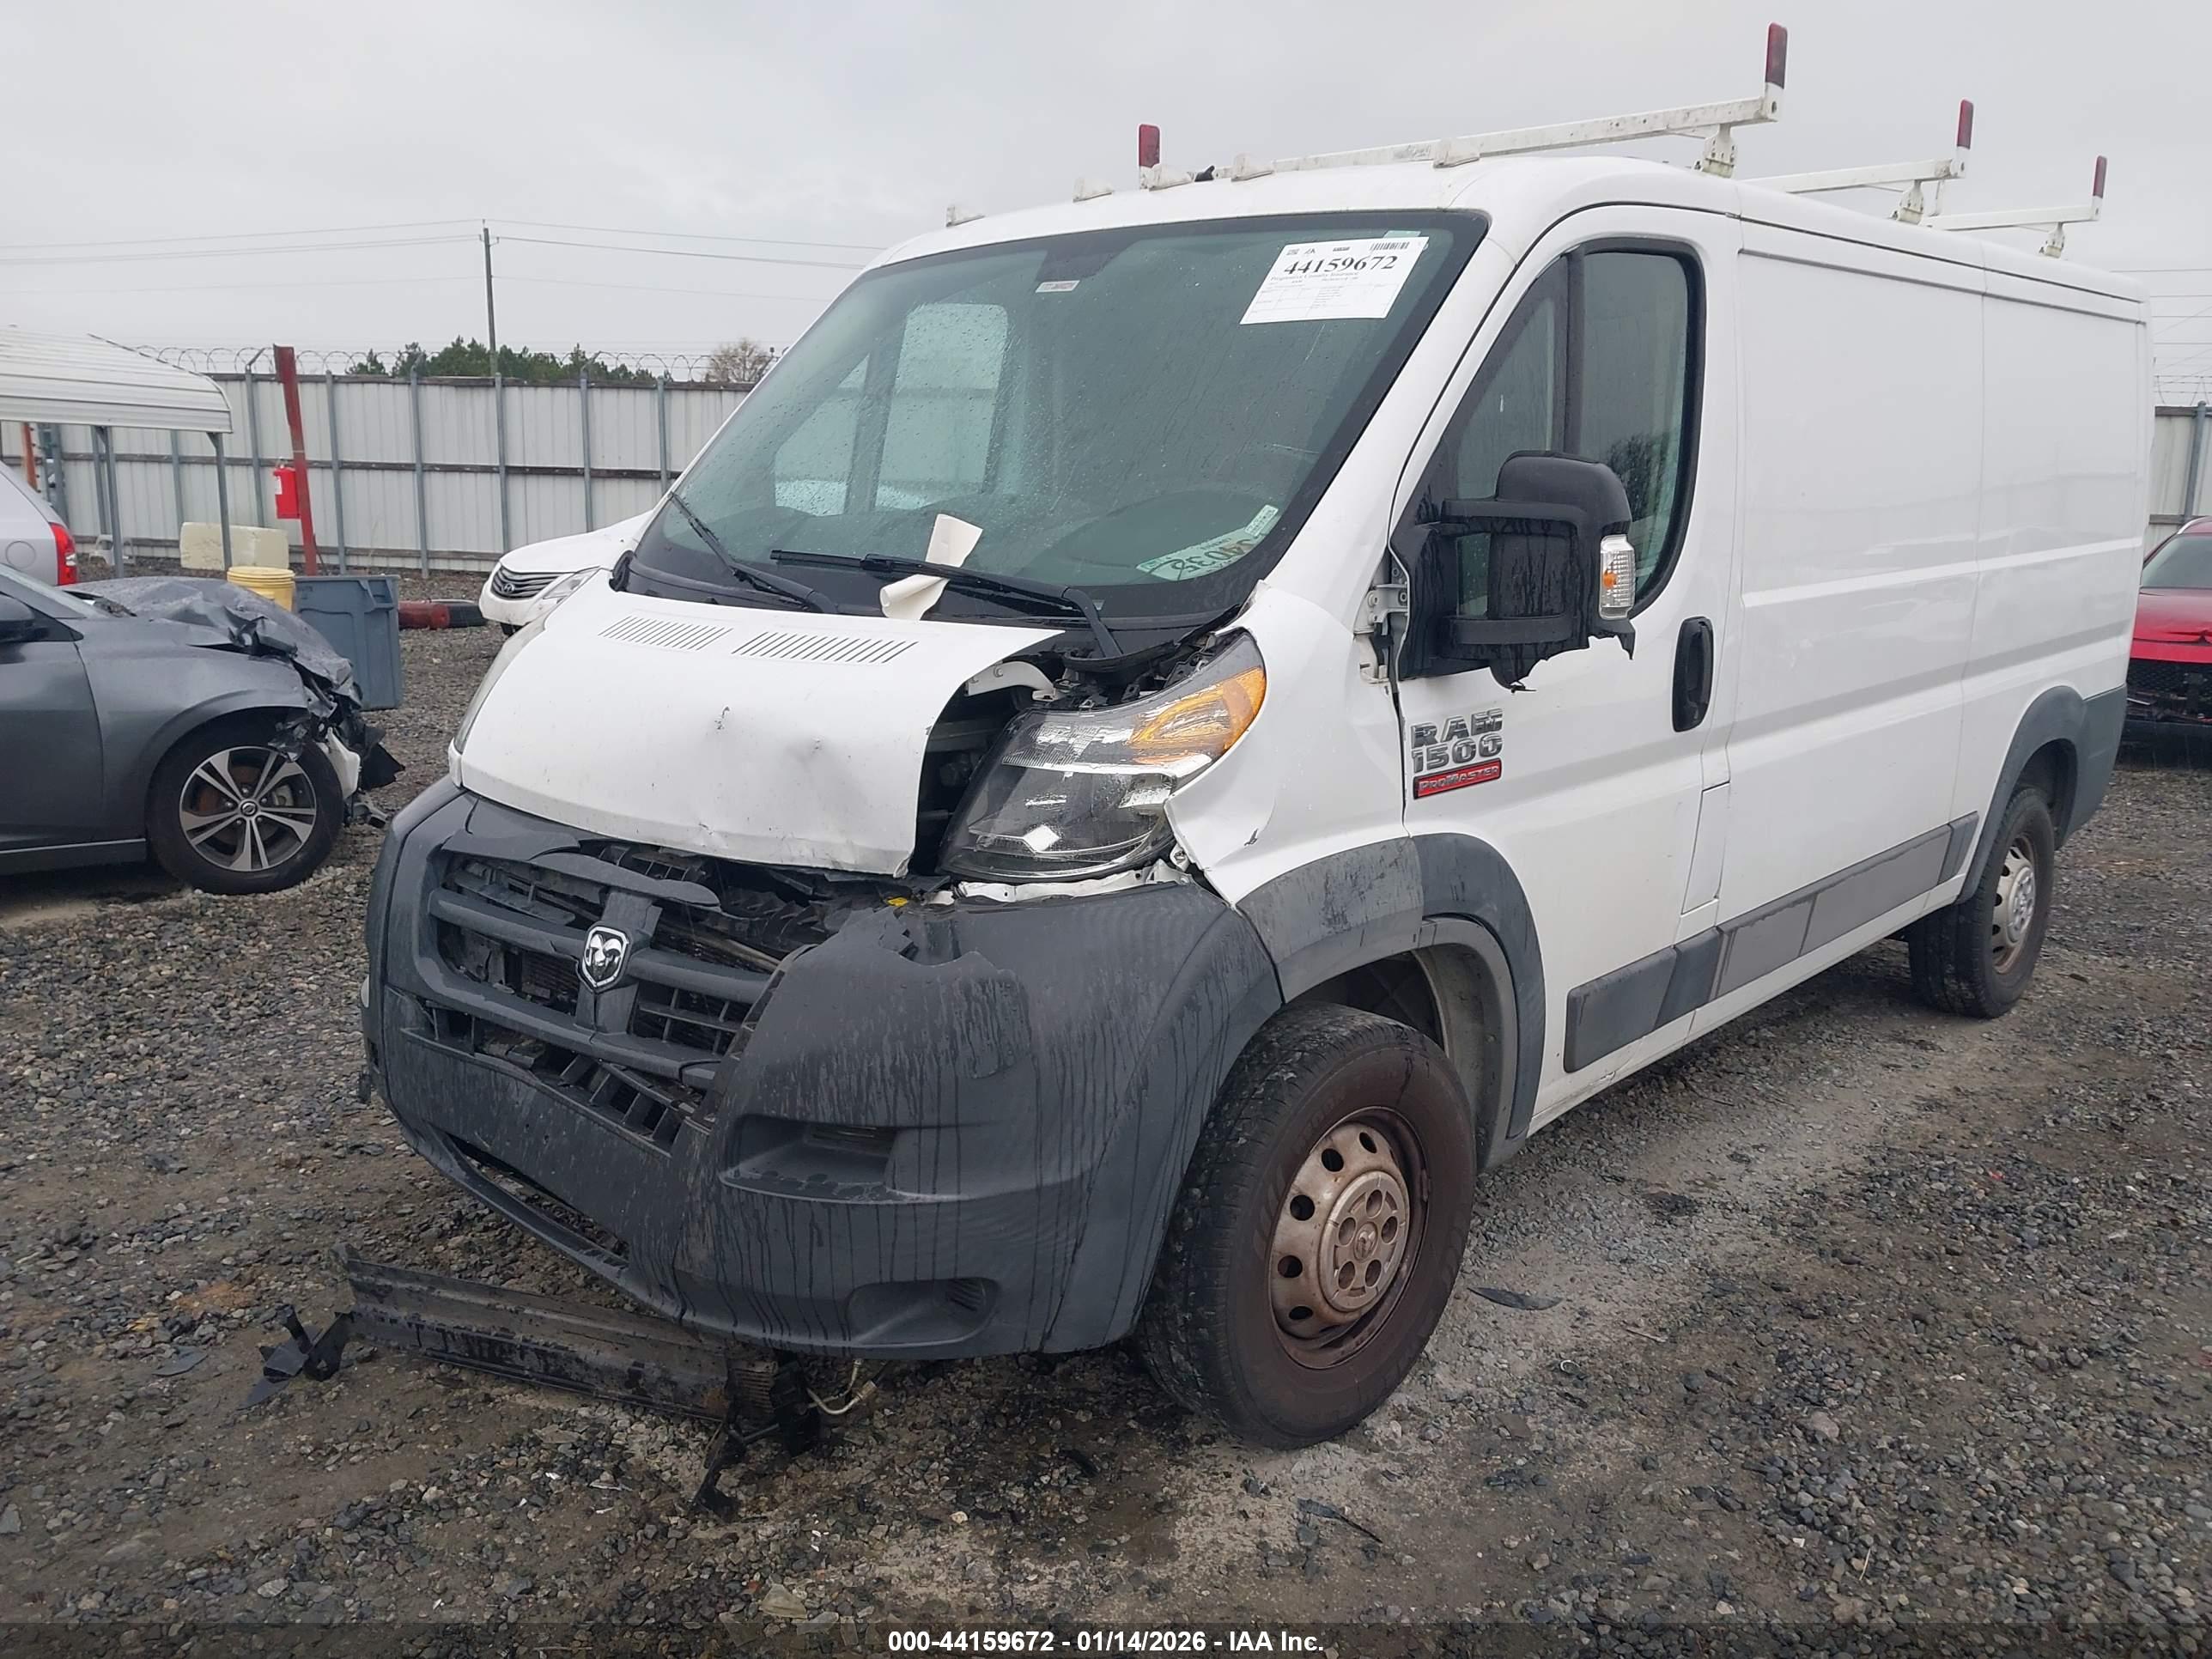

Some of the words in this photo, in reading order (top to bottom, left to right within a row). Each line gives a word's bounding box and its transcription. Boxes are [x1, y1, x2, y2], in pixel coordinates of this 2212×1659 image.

[1284, 255, 1398, 275] 44159672
[1411, 708, 1503, 749] RAM
[1411, 732, 1503, 774] 1500
